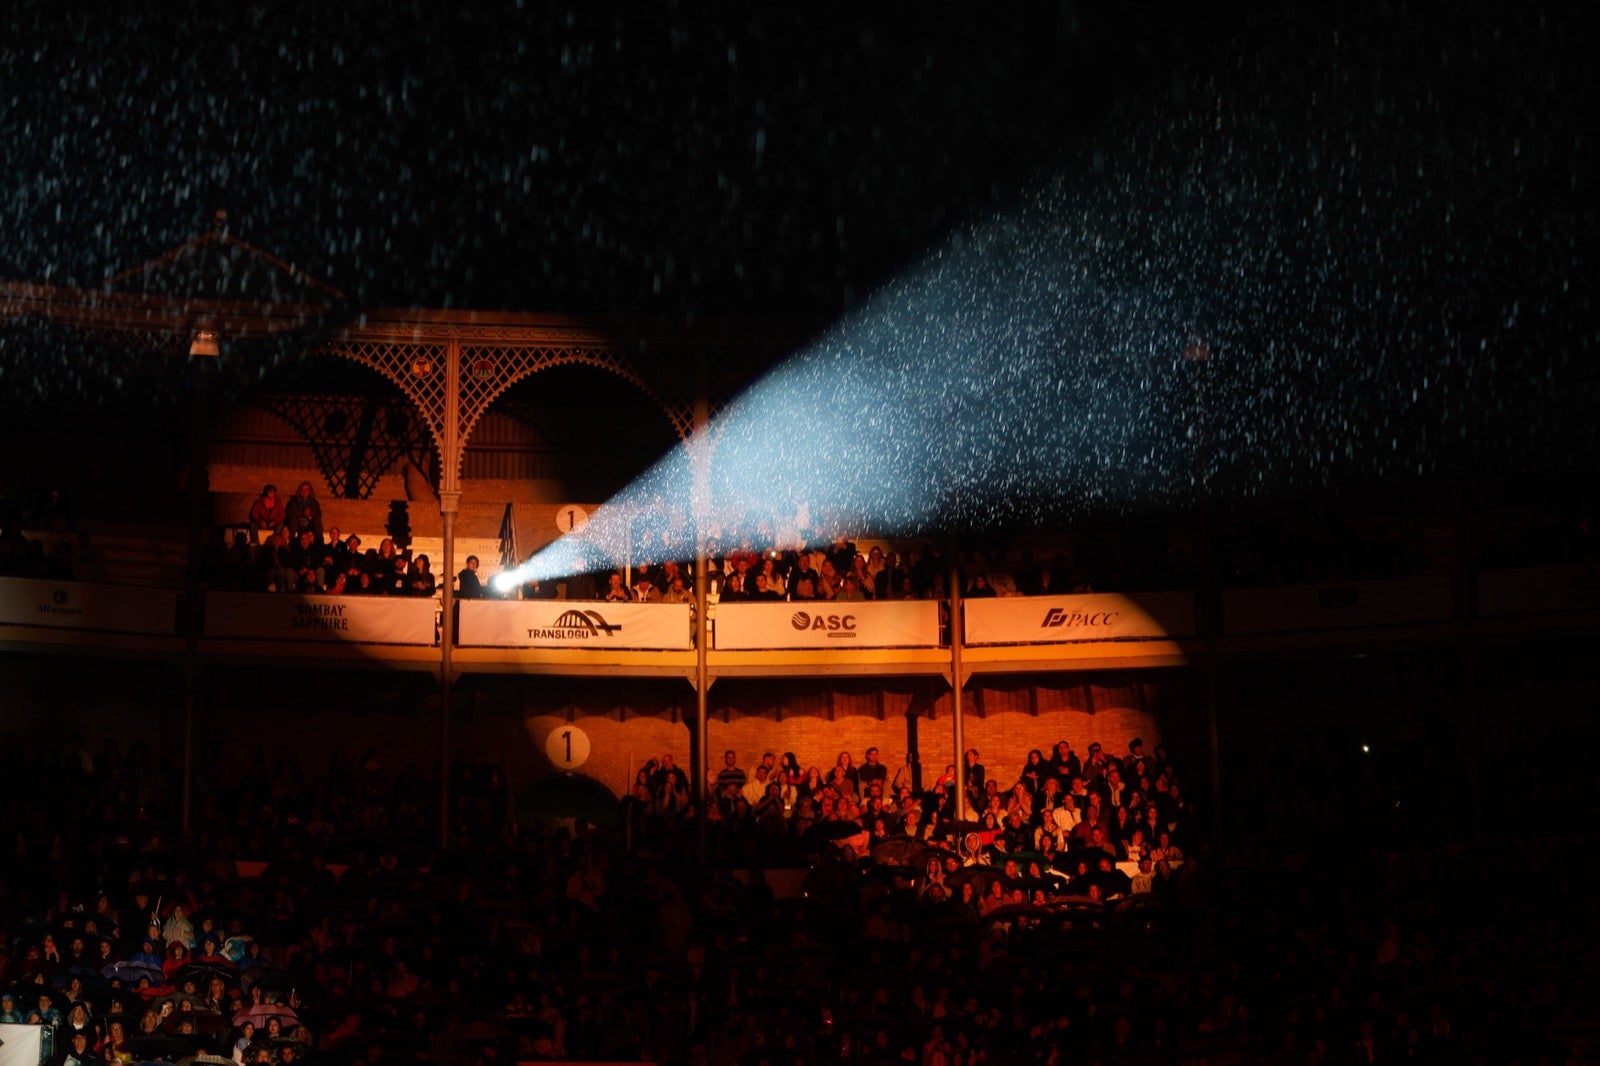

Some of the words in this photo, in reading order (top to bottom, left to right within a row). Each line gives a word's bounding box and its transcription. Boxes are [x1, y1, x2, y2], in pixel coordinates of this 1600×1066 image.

[568, 510, 575, 531] 1
[296, 604, 346, 616] BOMBAY
[292, 617, 348, 631] SAPPHIRE
[811, 615, 856, 630] ASC
[1067, 612, 1119, 627] PACC
[561, 730, 572, 762] 1
